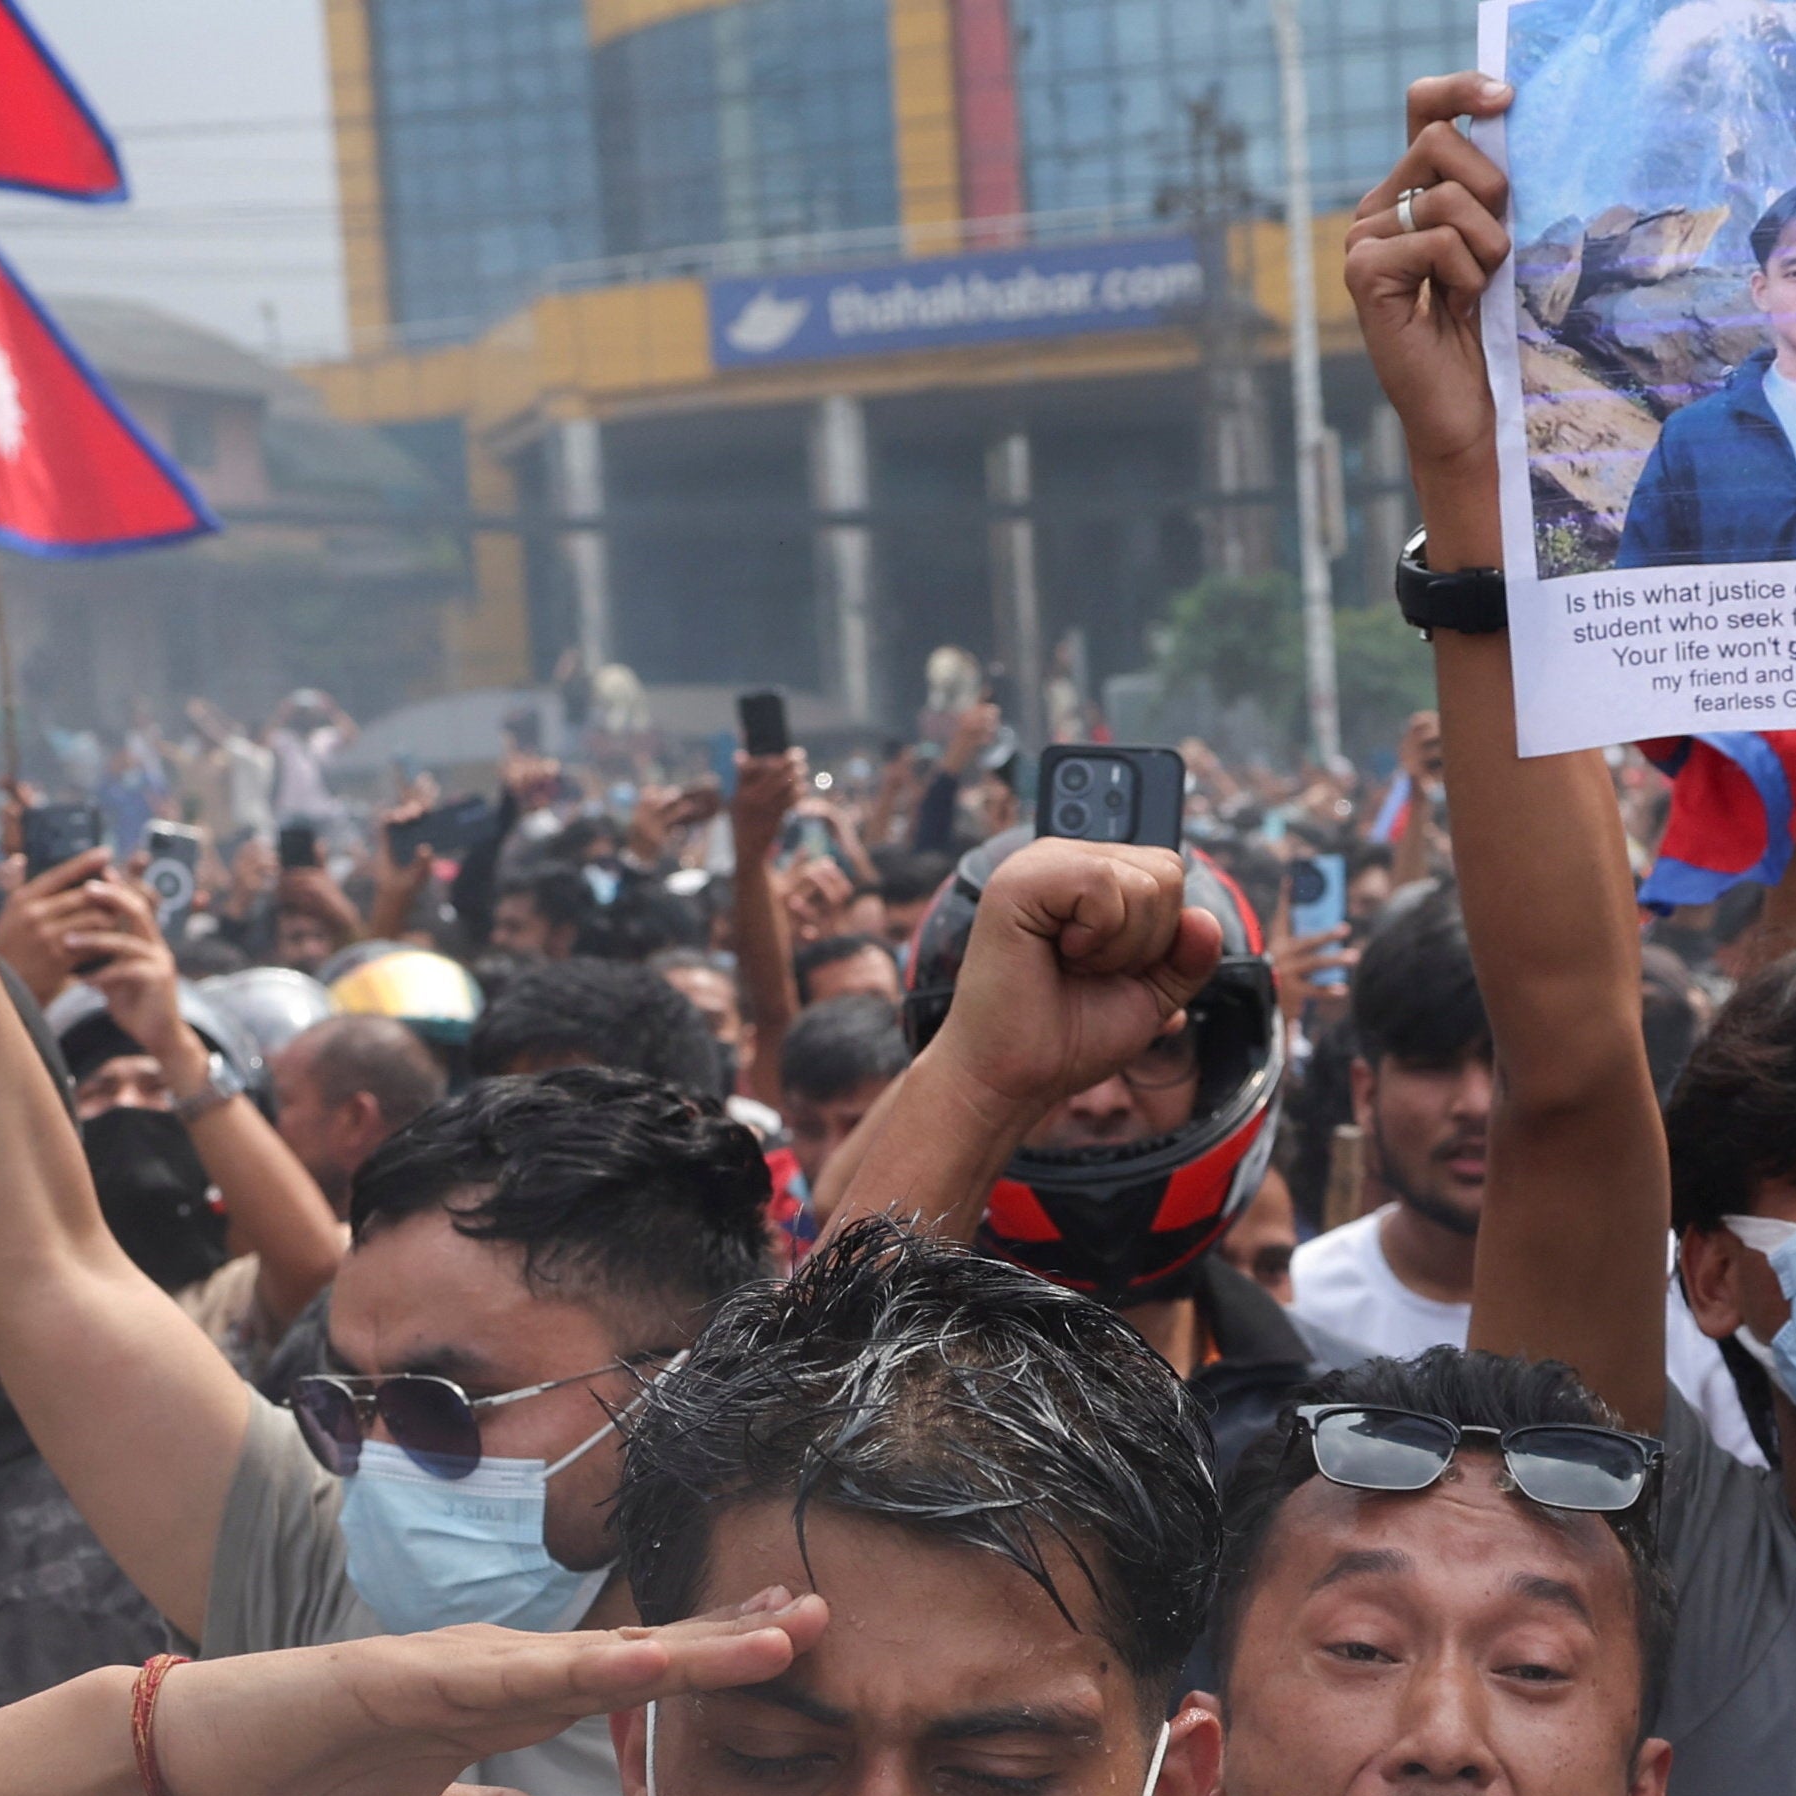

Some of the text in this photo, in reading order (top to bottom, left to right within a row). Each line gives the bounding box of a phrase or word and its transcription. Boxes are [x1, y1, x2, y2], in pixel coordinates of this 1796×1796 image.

[1566, 593, 1586, 614] Is
[1593, 587, 1636, 610] this
[1643, 582, 1702, 605] what
[1707, 580, 1784, 606] justice
[1573, 614, 1662, 644] student
[1668, 611, 1719, 632] who
[1727, 608, 1784, 630] seek
[1612, 646, 1668, 667] Your
[1675, 640, 1710, 662] life
[1717, 636, 1781, 660] won't
[1652, 675, 1683, 693] my
[1689, 667, 1749, 687] friend
[1755, 665, 1794, 684] and
[1693, 692, 1777, 712] fearless
